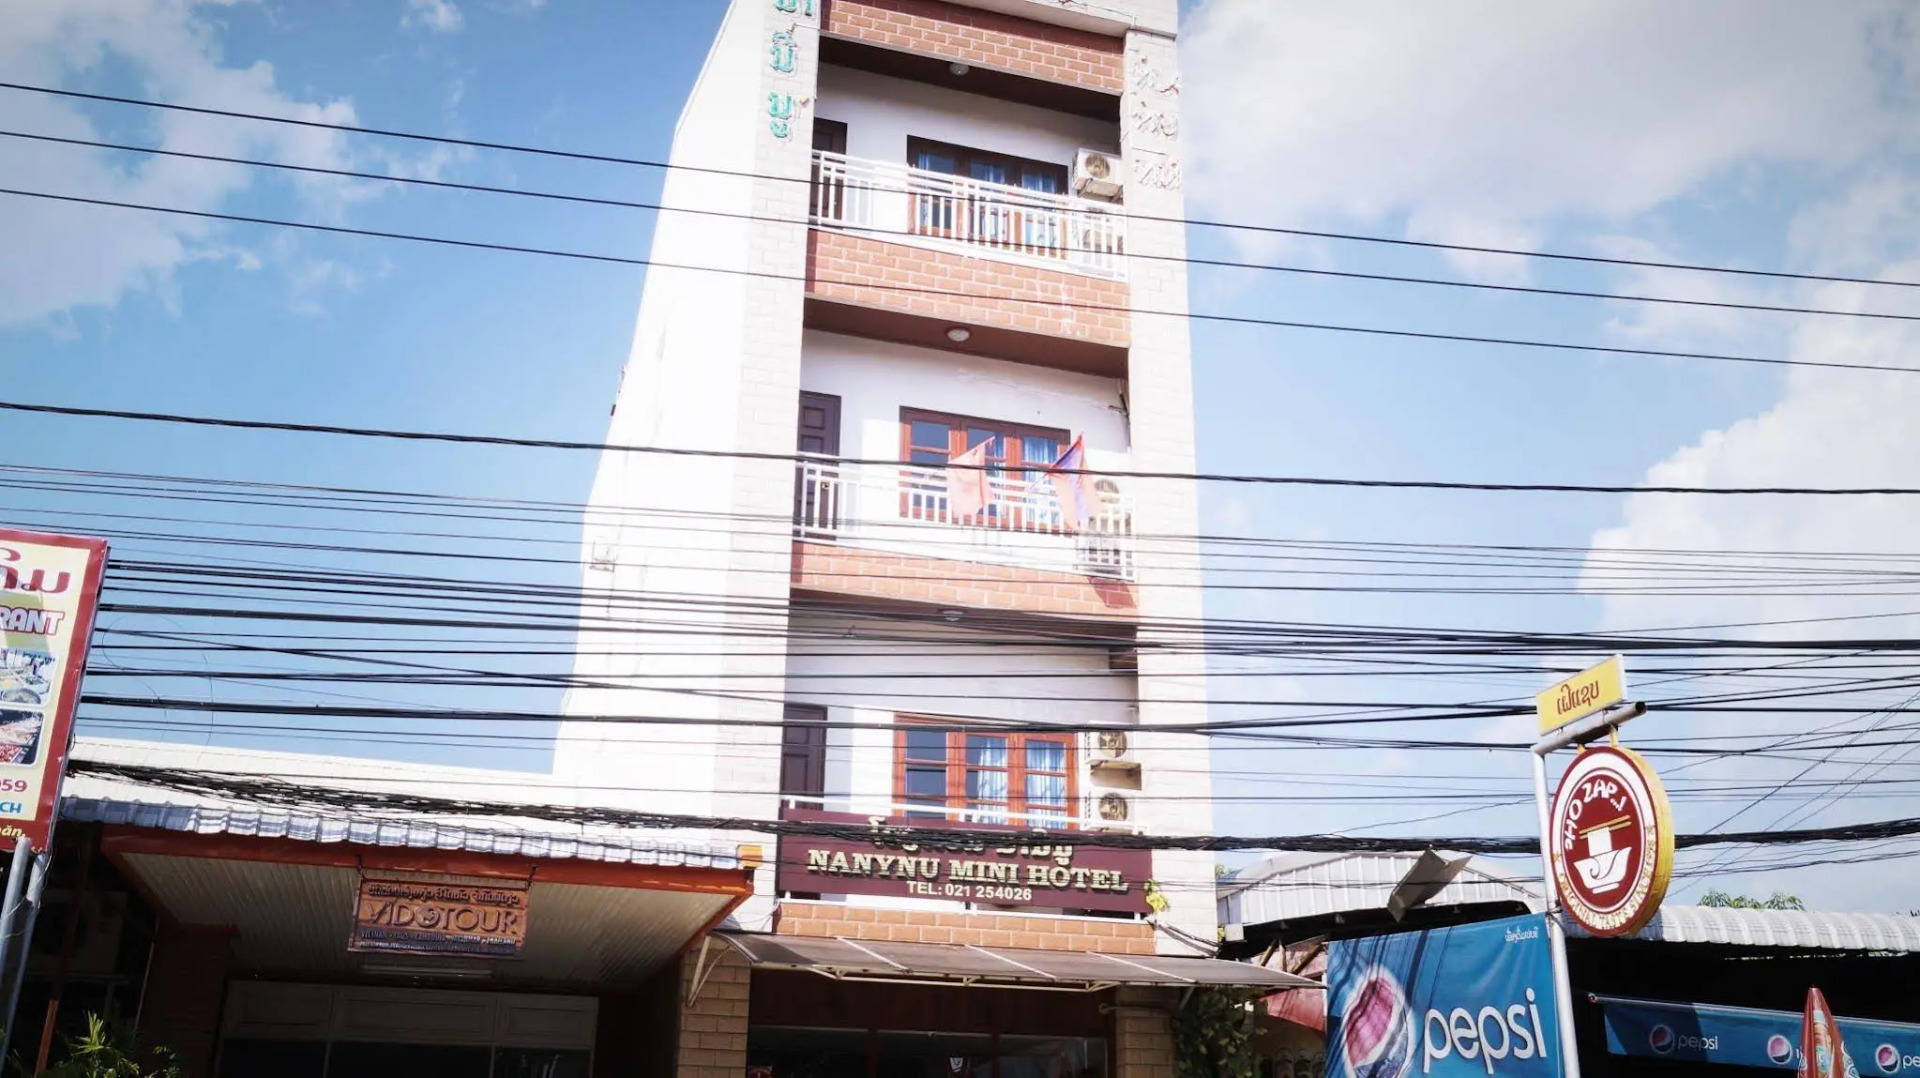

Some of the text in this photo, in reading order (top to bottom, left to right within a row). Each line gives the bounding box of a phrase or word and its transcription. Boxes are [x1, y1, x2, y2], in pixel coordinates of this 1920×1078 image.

[0, 778, 27, 793] 59
[1564, 799, 1583, 850] PHO
[807, 849, 1129, 892] NANYNU MINI HOTEL
[976, 886, 1032, 901] 254026
[1423, 987, 1547, 1075] pepsi
[1677, 1034, 1719, 1052] pepsi
